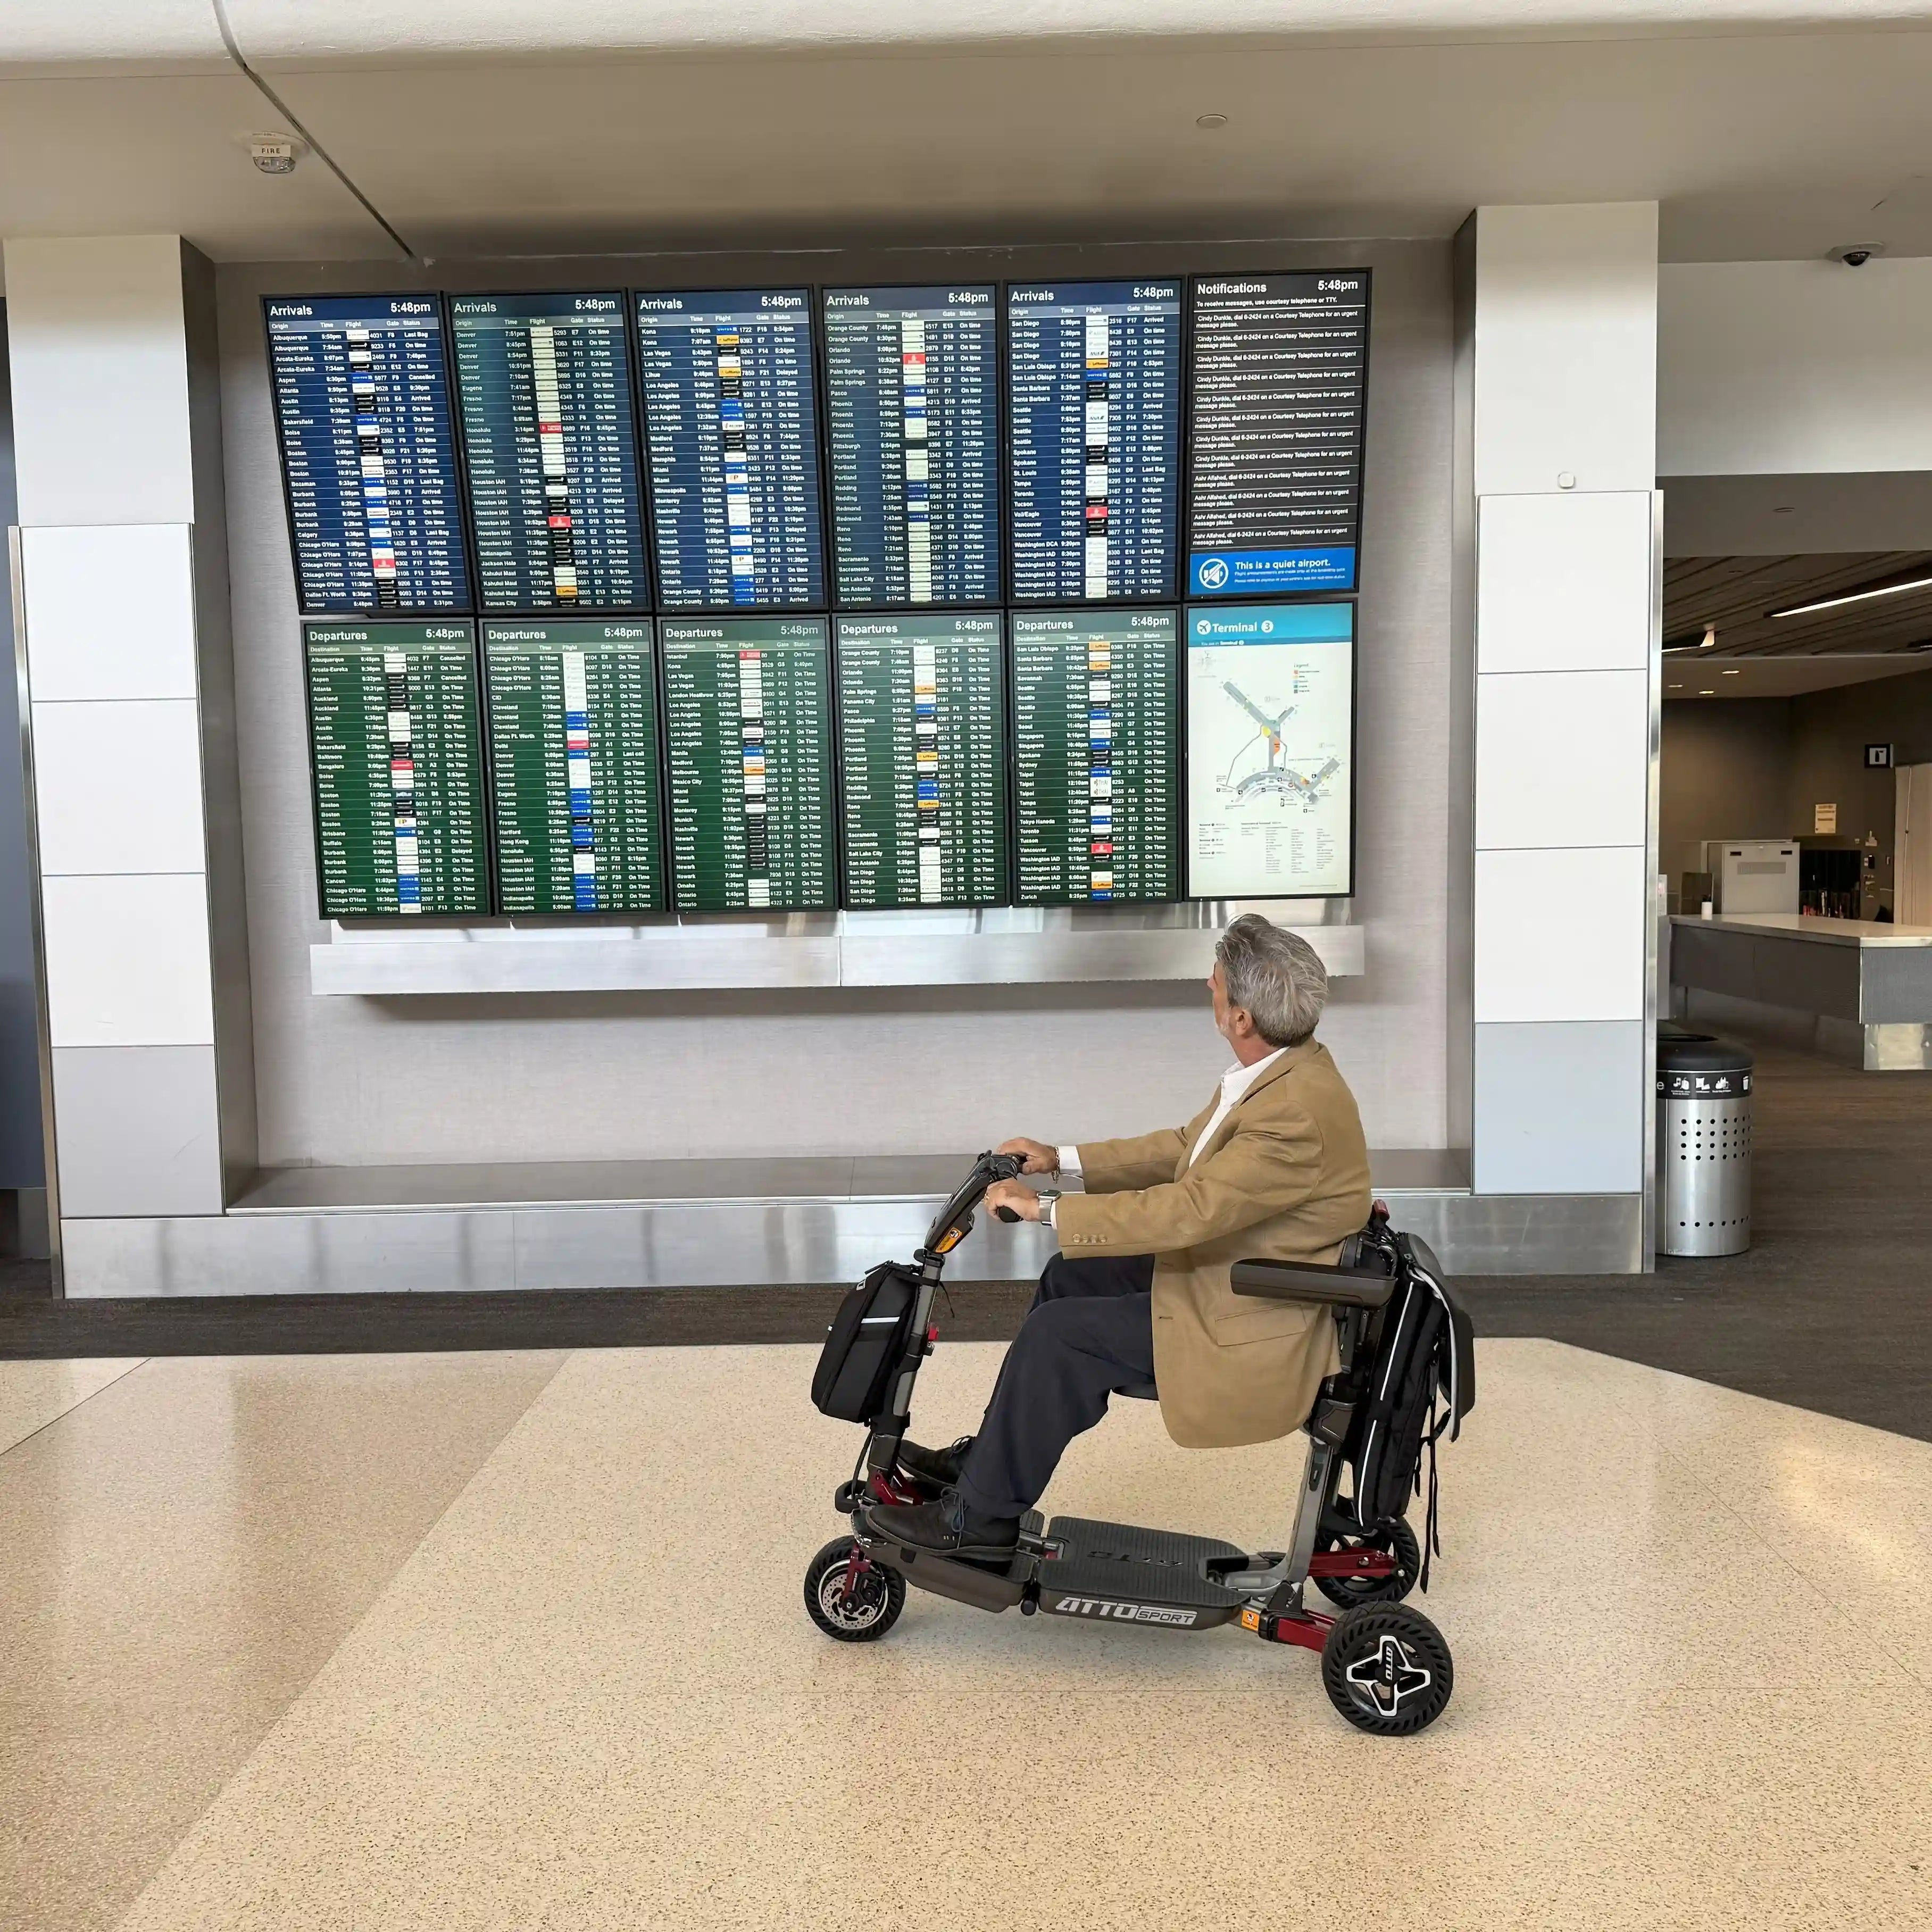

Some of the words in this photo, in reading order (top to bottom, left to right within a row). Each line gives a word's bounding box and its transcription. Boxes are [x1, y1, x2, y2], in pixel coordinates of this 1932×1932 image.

[1011, 290, 1054, 301] Arrivals
[1134, 287, 1173, 299] 5:48pm
[1198, 282, 1267, 294] Notifications
[1318, 280, 1358, 292] 5:48pm
[454, 302, 496, 313] Arrivals
[576, 299, 615, 311] 5:48pm
[640, 298, 682, 309] Arrivals
[762, 296, 801, 308] 5:48pm
[827, 295, 869, 306] Arrivals
[948, 292, 988, 304] 5:48pm
[270, 305, 312, 316] Arrivals
[391, 302, 430, 314] 5:48pm
[1235, 561, 1253, 570] This
[1272, 560, 1295, 570] quiet
[1298, 559, 1330, 568] airport.
[841, 624, 898, 636] Departures
[955, 621, 993, 632] 5:48pm
[1017, 621, 1073, 632] Departures
[1131, 617, 1169, 628] 5:48pm
[1212, 622, 1257, 632] Terminal
[1264, 622, 1270, 631] 3
[310, 631, 368, 643] Departures
[426, 629, 464, 640] 5:48pm
[488, 630, 546, 642] Departures
[604, 628, 642, 639] 5:48pm
[666, 628, 723, 639] Departures
[781, 626, 818, 636] 5:48pm
[1055, 1596, 1139, 1619] ATTO
[1138, 1611, 1195, 1625] SPORT
